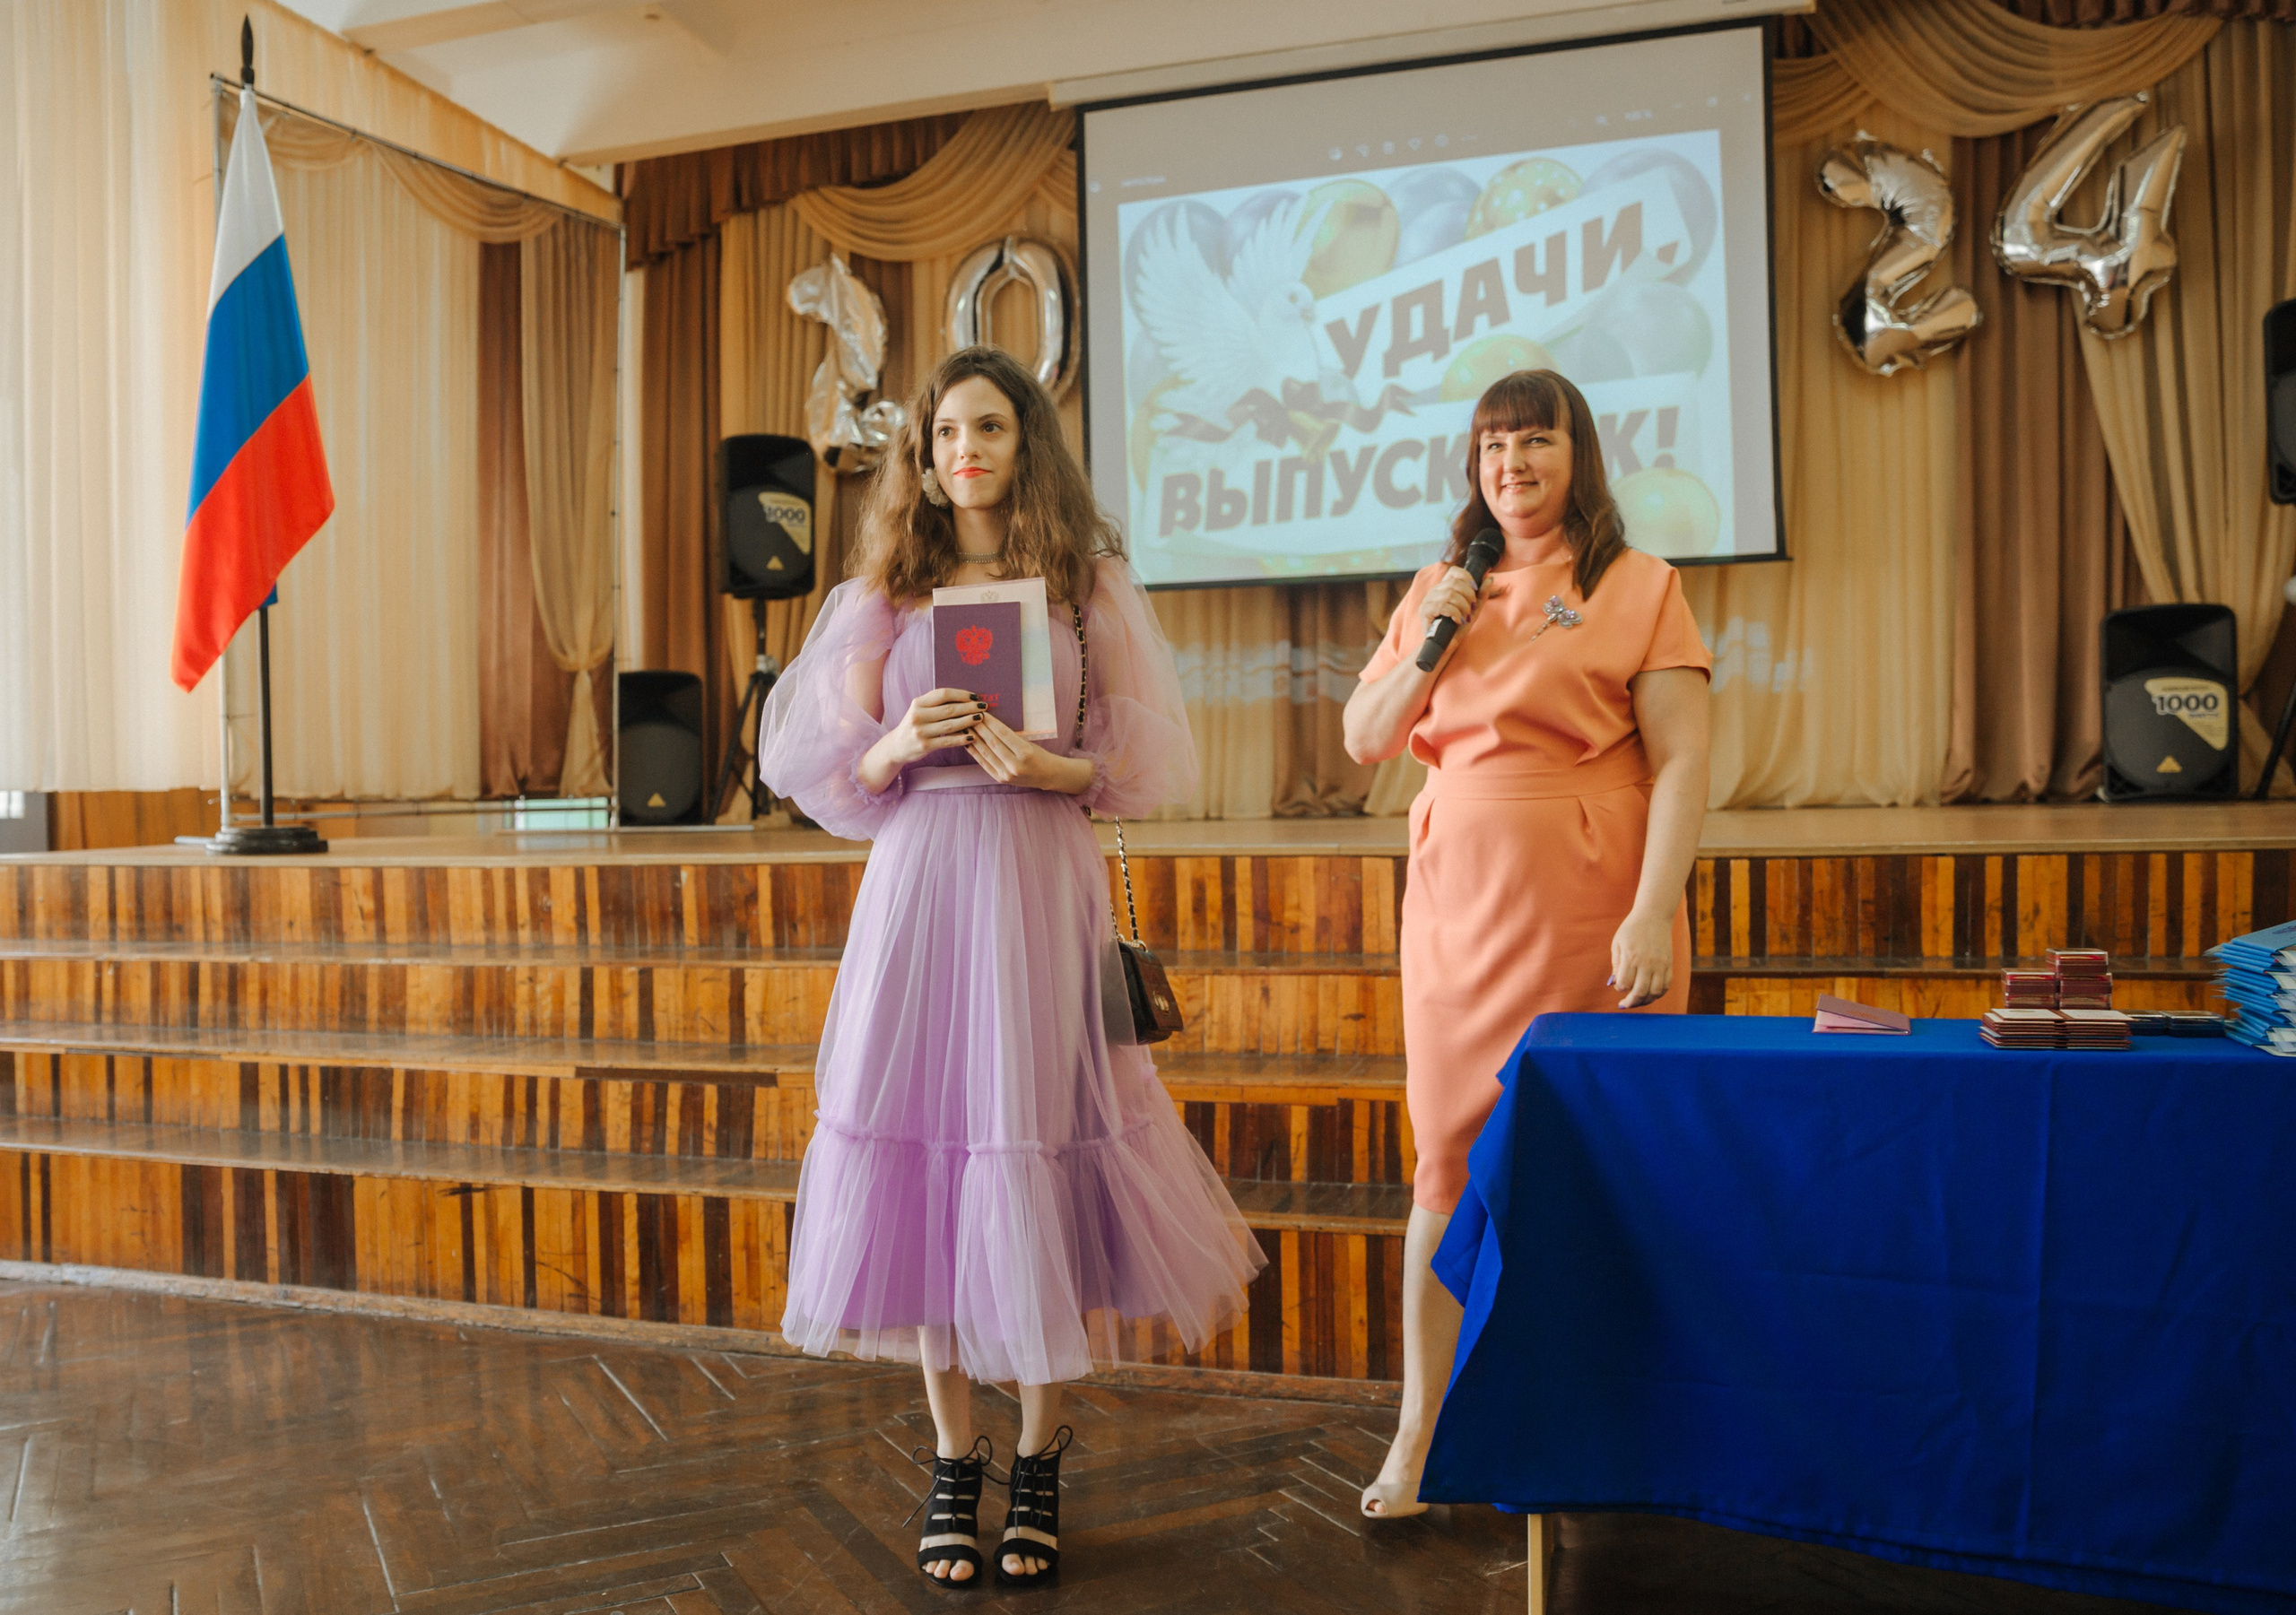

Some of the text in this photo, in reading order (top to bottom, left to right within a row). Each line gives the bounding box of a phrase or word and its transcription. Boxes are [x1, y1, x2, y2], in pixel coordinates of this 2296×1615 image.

[1324, 200, 1679, 380] УДАЧИ,
[1160, 404, 1680, 538] ВЫПУСКК!
[767, 505, 806, 525] 1000
[2157, 693, 2219, 713] 1000
